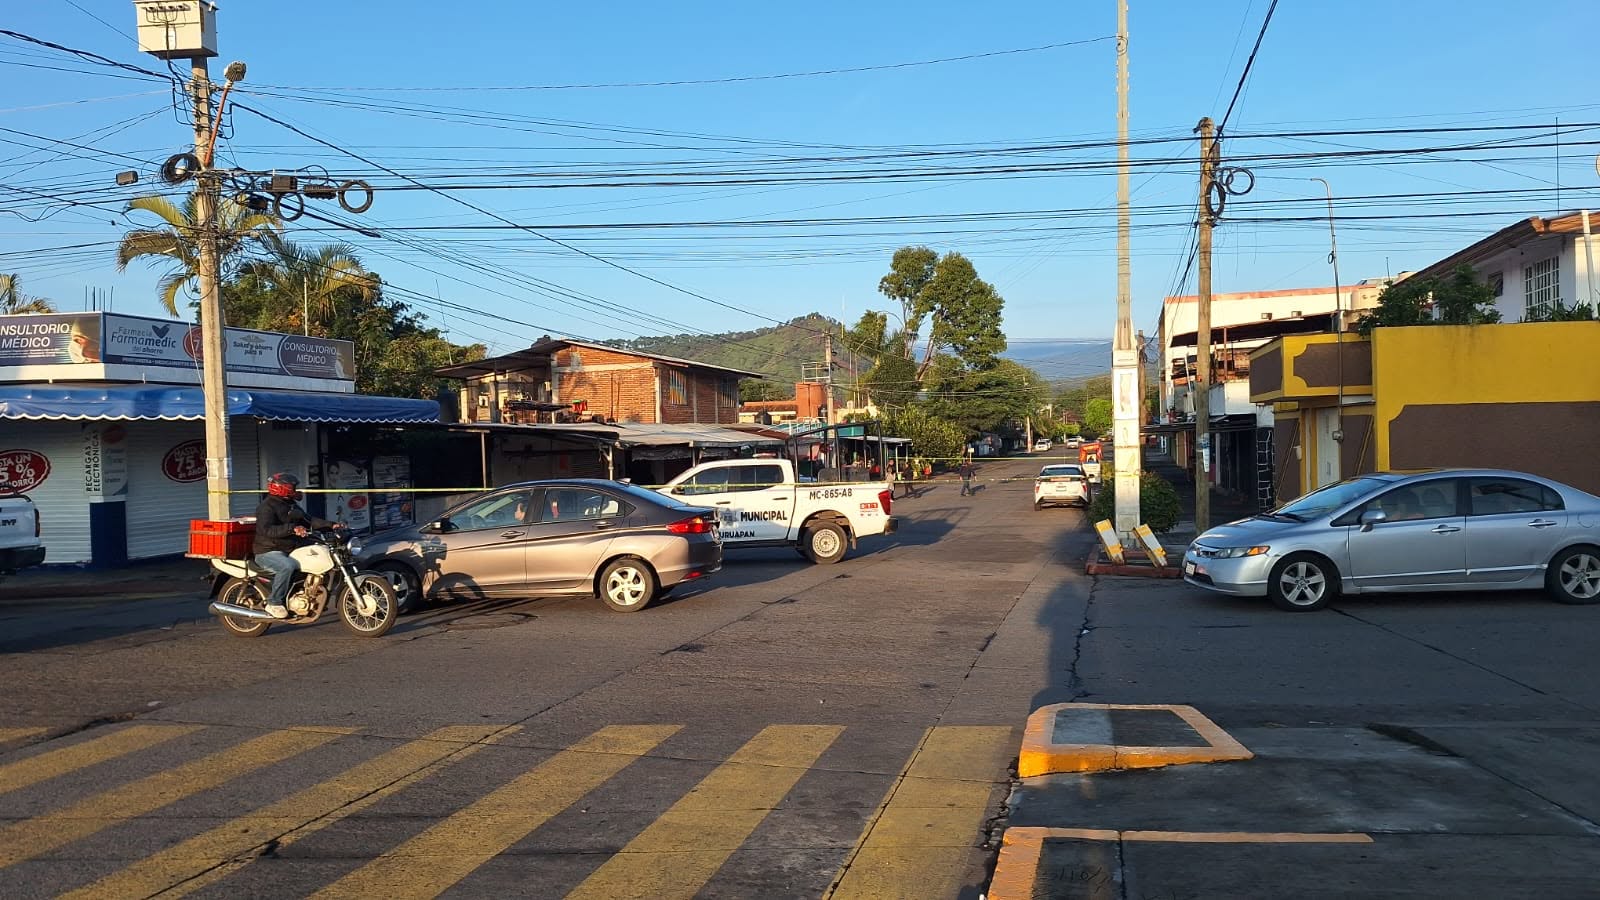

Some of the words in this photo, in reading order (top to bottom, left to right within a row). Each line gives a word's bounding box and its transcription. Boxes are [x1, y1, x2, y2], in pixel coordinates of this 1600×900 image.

[118, 327, 152, 337] Farmacia
[1, 336, 51, 349] MÉDICO
[111, 331, 177, 348] Farmamedic
[142, 346, 164, 354] ahorro
[254, 343, 273, 351] ahorro
[284, 342, 337, 355] CONSULTORIO
[16, 454, 31, 463] UN
[175, 456, 195, 472] 75
[84, 445, 93, 492] RECARGAS
[740, 510, 788, 522] MUNICIPAL
[719, 531, 755, 539] URUAPAN
